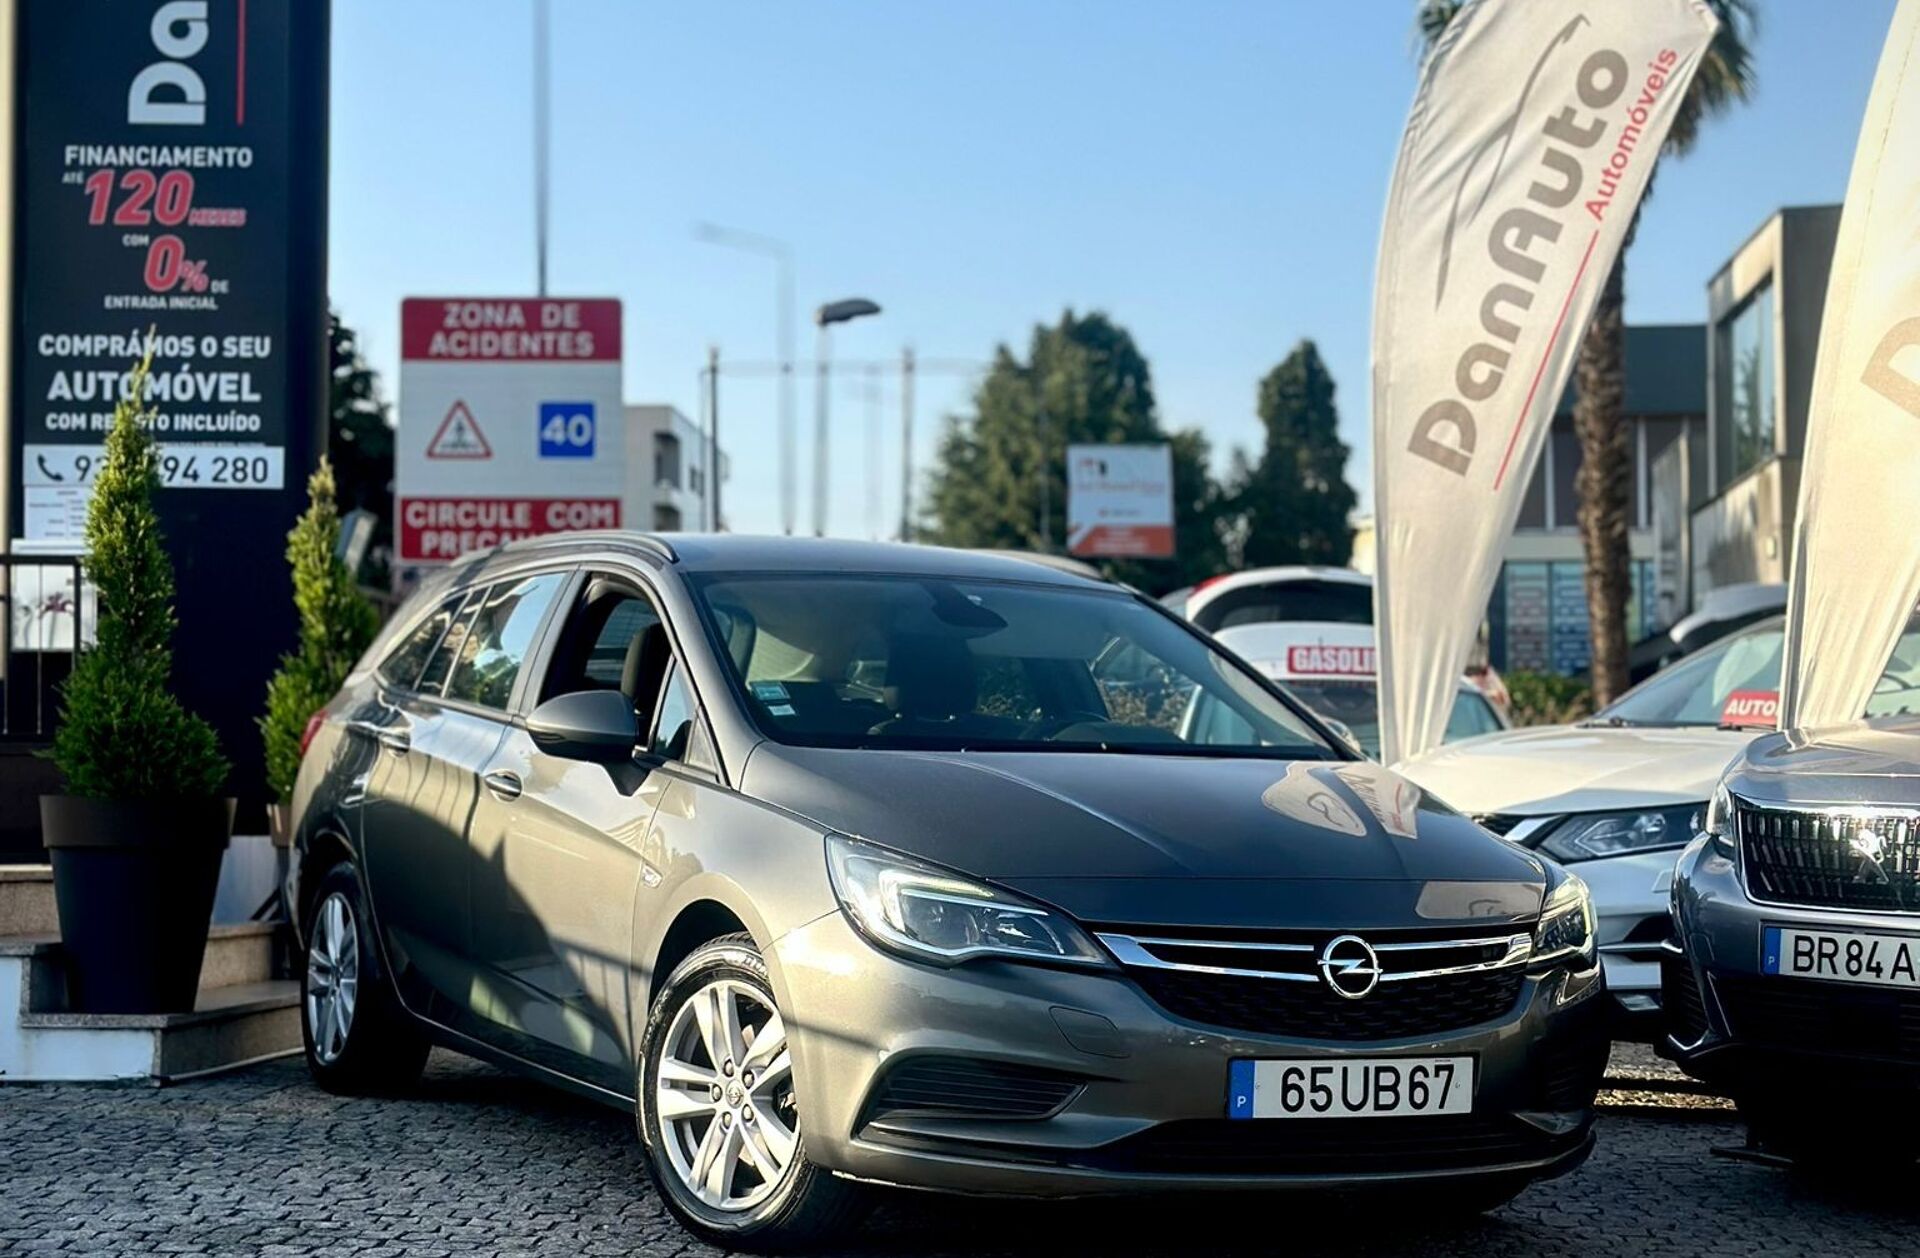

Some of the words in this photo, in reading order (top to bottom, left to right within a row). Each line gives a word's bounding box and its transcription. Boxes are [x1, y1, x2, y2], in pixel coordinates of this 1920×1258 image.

[1585, 48, 1678, 222] Automóveis
[64, 146, 253, 167] FINANCIAMENTO
[85, 169, 194, 226] 120
[122, 234, 150, 247] COM
[144, 234, 209, 292] 0%
[211, 280, 229, 294] DE
[1406, 49, 1629, 477] DanAuto
[104, 296, 167, 310] ENTRADA
[169, 297, 218, 311] INICIAL
[444, 303, 525, 329] ZONA
[541, 303, 581, 329] DE
[38, 328, 195, 358] COMPRÁMOS
[200, 336, 218, 358] O
[222, 336, 271, 358] SEU
[428, 331, 594, 357] ACIDENTES
[45, 413, 87, 430] COM
[173, 410, 261, 431] INCLUÍDO
[542, 414, 591, 446] 40
[211, 456, 269, 483] 280
[405, 502, 531, 528] CIRCULE
[546, 502, 614, 528] COM
[1724, 698, 1779, 717] AUTO
[1236, 1096, 1246, 1109] P
